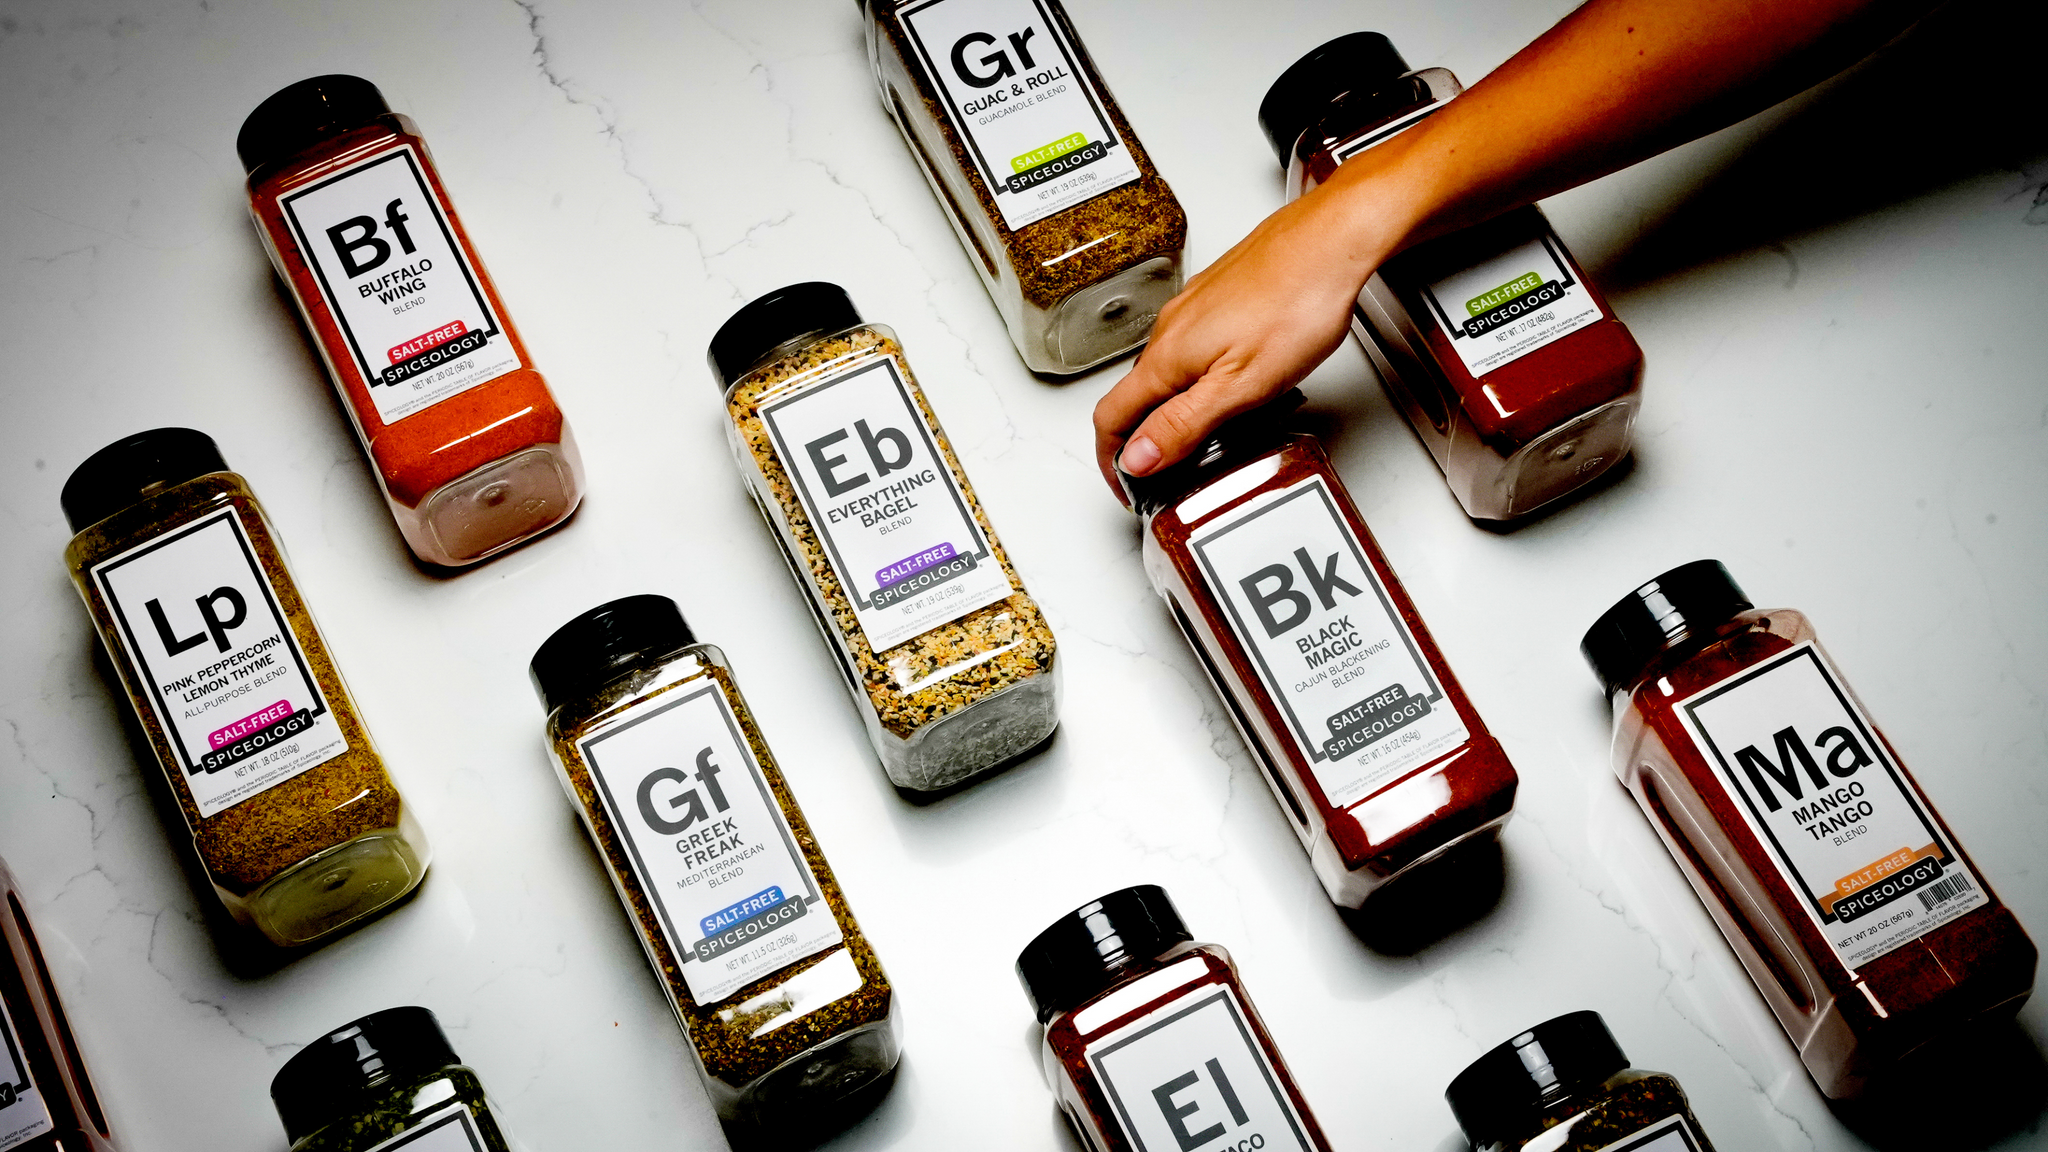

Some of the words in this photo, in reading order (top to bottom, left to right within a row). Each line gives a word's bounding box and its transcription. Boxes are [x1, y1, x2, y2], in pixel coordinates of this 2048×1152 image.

[950, 26, 1037, 89] Gr
[963, 89, 1008, 116] GUAC
[1011, 83, 1025, 97] &
[1025, 66, 1068, 90] ROLL
[978, 97, 1035, 126] GUACAMOLE
[1035, 84, 1067, 103] BLEND
[1011, 145, 1100, 189] SPICEOLOGY
[1016, 136, 1082, 169] SALT-FREE
[1037, 190, 1050, 201] NET
[1060, 182, 1070, 192] 19
[1068, 178, 1079, 188] OZ
[1077, 171, 1098, 186] (539g)
[325, 197, 417, 280] Bf
[358, 258, 433, 299] BUFFALO
[377, 277, 427, 305] WING
[1471, 275, 1538, 312] SALT-FREE
[392, 296, 426, 316] BLEND
[1468, 285, 1557, 334] SPICEOLOGY
[1495, 331, 1509, 343] NET
[1518, 322, 1527, 332] 17
[1526, 318, 1537, 329] OZ
[1535, 310, 1556, 326] (482g)
[386, 333, 479, 382] SPICEOLOGY
[392, 323, 462, 360] SALT-FREE
[411, 379, 425, 391] NET
[435, 371, 446, 381] 20
[444, 366, 455, 377] OZ
[454, 359, 475, 374] (567g)
[804, 418, 913, 499] Eb
[827, 469, 936, 524] EVERYTHING
[860, 496, 918, 528] BAGEL
[878, 516, 912, 536] BLEND
[875, 556, 969, 605] SPICEOLOGY
[880, 545, 951, 582] SALT-FREE
[901, 603, 915, 615] NET
[926, 595, 936, 606] 19
[934, 591, 945, 602] OZ
[944, 583, 965, 599] (539g)
[1238, 546, 1364, 640] Bk
[144, 586, 248, 658] Lp
[1295, 615, 1355, 654] BLACK
[162, 674, 196, 696] PINK
[197, 634, 282, 681] PEPPERCORN
[1294, 671, 1328, 693] CAJUN
[1328, 639, 1391, 676] BLACKENING
[1304, 632, 1363, 670] MAGIC
[182, 675, 230, 703] LEMON
[229, 653, 275, 681] THYME
[184, 683, 253, 720] ALL-PURPOSE
[253, 665, 287, 688] BLEND
[1331, 666, 1365, 689] BLEND
[213, 703, 288, 745] SALT-FREE
[1329, 699, 1423, 756] SPICEOLOGY
[1332, 687, 1403, 730] SALT-FREE
[207, 714, 306, 769] SPICEOLOGY
[234, 765, 248, 778] NET
[261, 756, 271, 767] 18
[269, 751, 280, 762] OZ
[279, 742, 300, 759] (510g)
[1357, 753, 1371, 767] NET
[1381, 743, 1392, 755] 16
[1390, 738, 1401, 750] OZ
[1399, 729, 1421, 747] (454g)
[1733, 725, 1874, 813] Ma
[636, 746, 731, 836] Gf
[1791, 781, 1865, 826] MANGO
[676, 816, 738, 854] GREEK
[1805, 800, 1874, 841] TANGO
[1832, 824, 1868, 847] BLEND
[676, 843, 765, 889] MEDITERRANEAN
[683, 832, 744, 870] FREAK
[1841, 852, 1911, 892] SALT-FREE
[708, 866, 744, 889] BLEND
[1839, 862, 1935, 918] SPICEOLOGY
[699, 901, 799, 957] SPICEOLOGY
[705, 889, 780, 932] SALT-FREE
[1837, 936, 1854, 949] NET
[1853, 930, 1867, 941] WT
[1867, 926, 1878, 935] 20
[1877, 919, 1891, 930] OZ
[1890, 908, 1914, 925] (567g)
[725, 958, 739, 972] NET
[751, 946, 767, 960] 11.5
[766, 941, 777, 953] OZ
[776, 932, 798, 950] (326g)
[1150, 1056, 1250, 1152] El
[1219, 1133, 1265, 1152] CO
